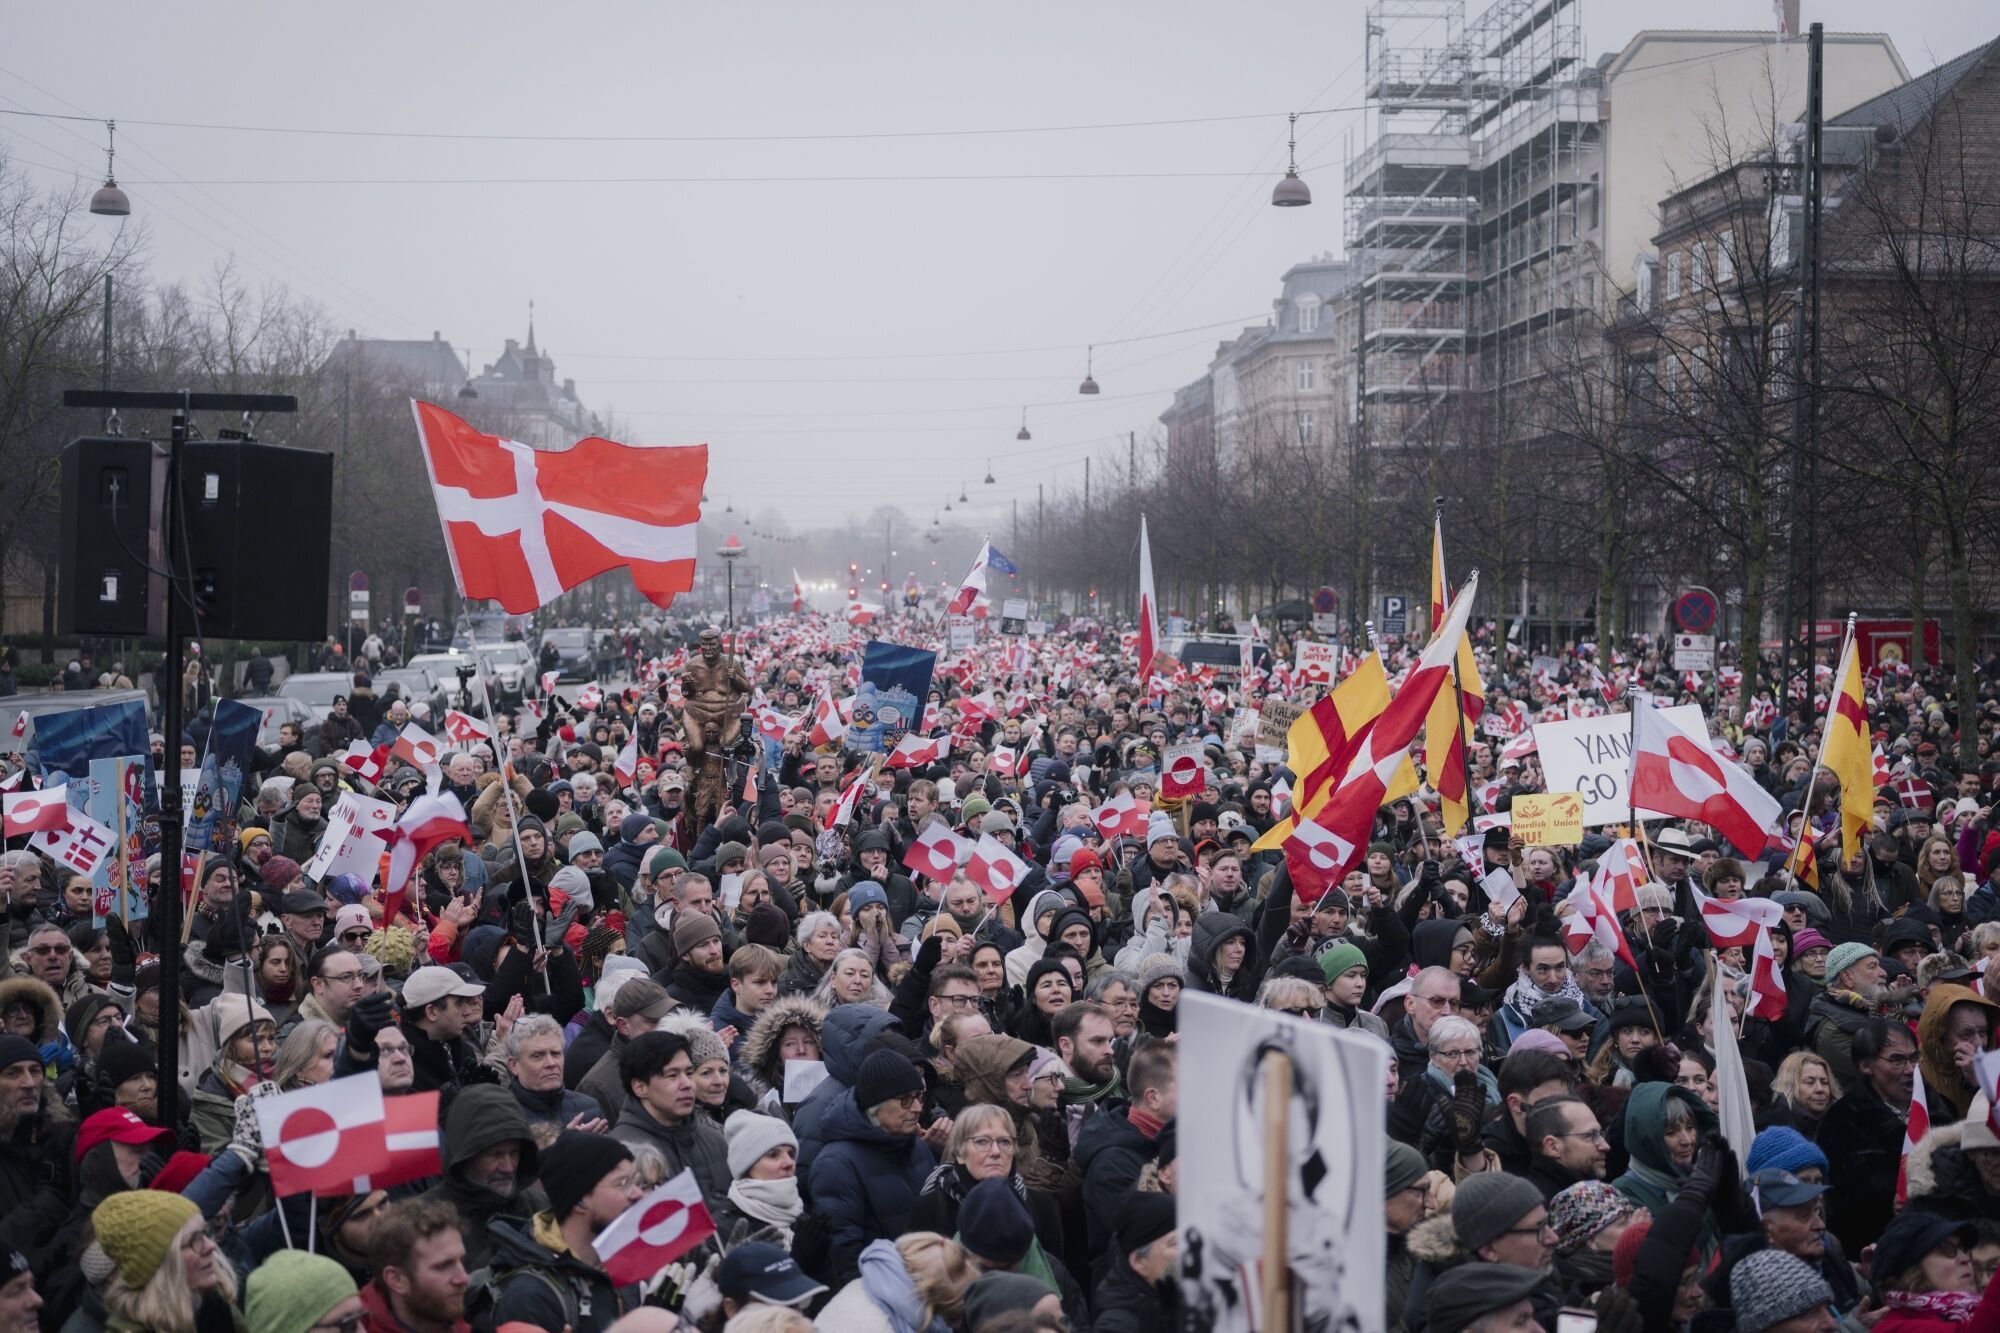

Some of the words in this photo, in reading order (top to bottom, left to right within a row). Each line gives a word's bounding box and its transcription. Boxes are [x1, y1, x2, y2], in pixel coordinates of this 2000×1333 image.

[1388, 598, 1401, 617] P
[1575, 731, 1632, 765] YAN
[1576, 773, 1617, 805] GO
[1513, 820, 1546, 830] Nordisk
[1553, 819, 1580, 828] Union
